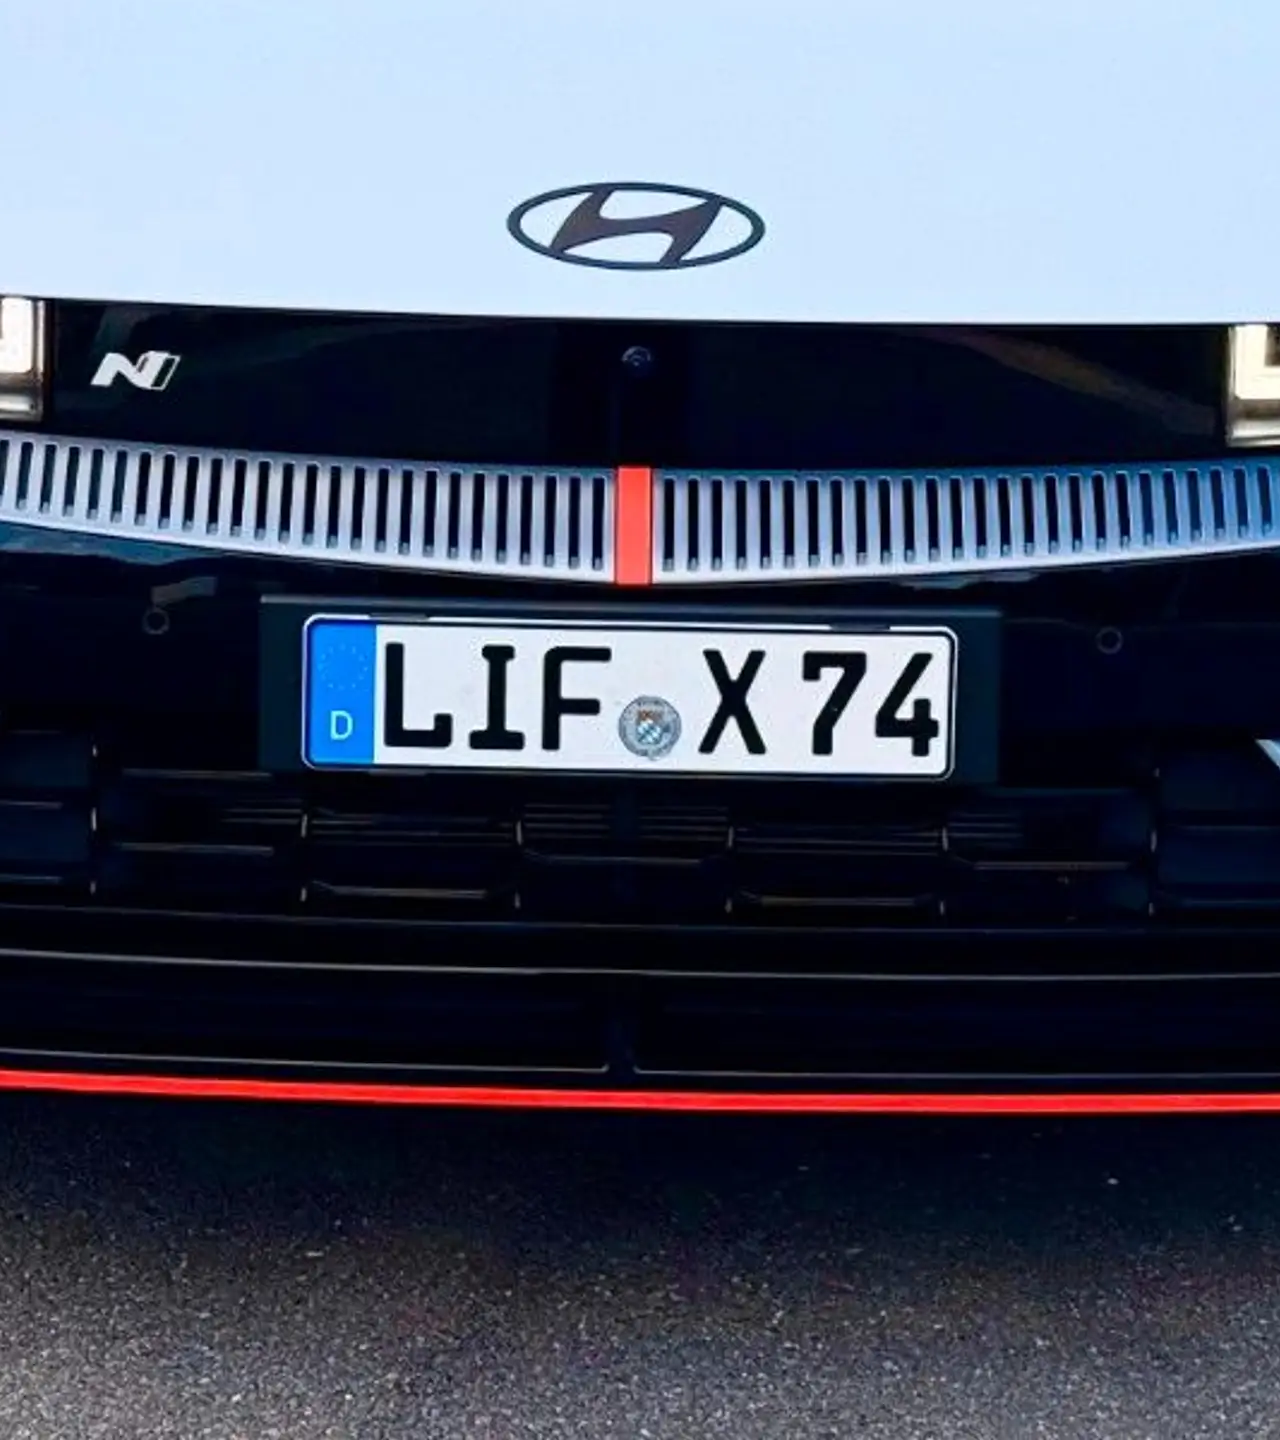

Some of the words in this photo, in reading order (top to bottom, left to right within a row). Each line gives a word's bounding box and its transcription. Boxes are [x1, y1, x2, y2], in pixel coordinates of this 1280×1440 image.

[330, 710, 354, 741] D
[383, 641, 613, 751] LIF
[698, 649, 767, 756] X
[802, 651, 940, 758] 74
